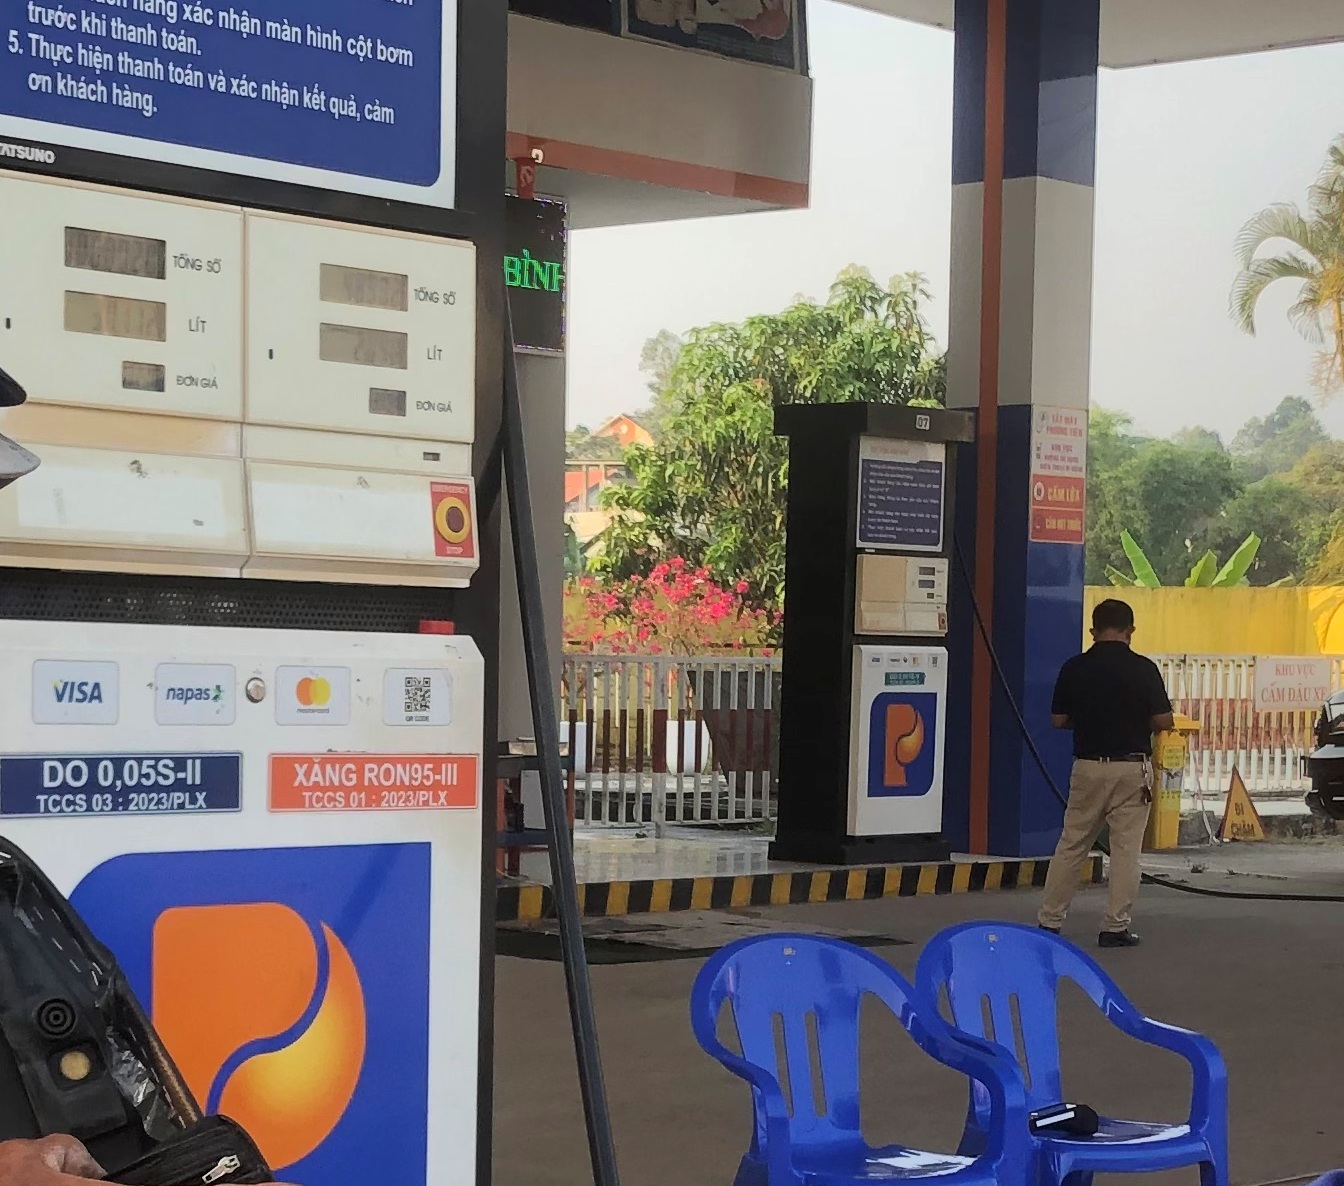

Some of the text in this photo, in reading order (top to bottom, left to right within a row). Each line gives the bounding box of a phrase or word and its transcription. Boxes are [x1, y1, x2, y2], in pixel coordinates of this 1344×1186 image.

[27, 1, 202, 56] trước khi thanh toán.
[183, 1, 213, 25] xác
[219, 8, 261, 38] nhận
[266, 19, 302, 44] màn
[307, 24, 342, 52] hình
[347, 35, 373, 62] cột
[377, 39, 414, 67] bơm
[8, 30, 394, 125] 5. Thực hiện thanh toán và xác nhận kết quả, cảm
[28, 72, 158, 117] ơn khách hàng.
[206, 259, 222, 274] SỐ
[188, 316, 207, 333] LÍT
[427, 345, 443, 361] LÍT
[176, 375, 218, 389] ĐƠN GIÁ
[917, 416, 929, 429] 07
[54, 681, 103, 704] VISA
[166, 686, 211, 705] napas
[1260, 681, 1285, 703] CẤM
[43, 758, 202, 791] DO 0,05S-II
[293, 756, 458, 787] XĂNG RON95-III
[36, 794, 87, 813] TCCS
[92, 794, 113, 812] 03
[128, 791, 207, 811] 2023/PLX
[302, 791, 345, 808] TCCS
[350, 791, 366, 808] 01
[380, 790, 448, 807] 2023/PLX
